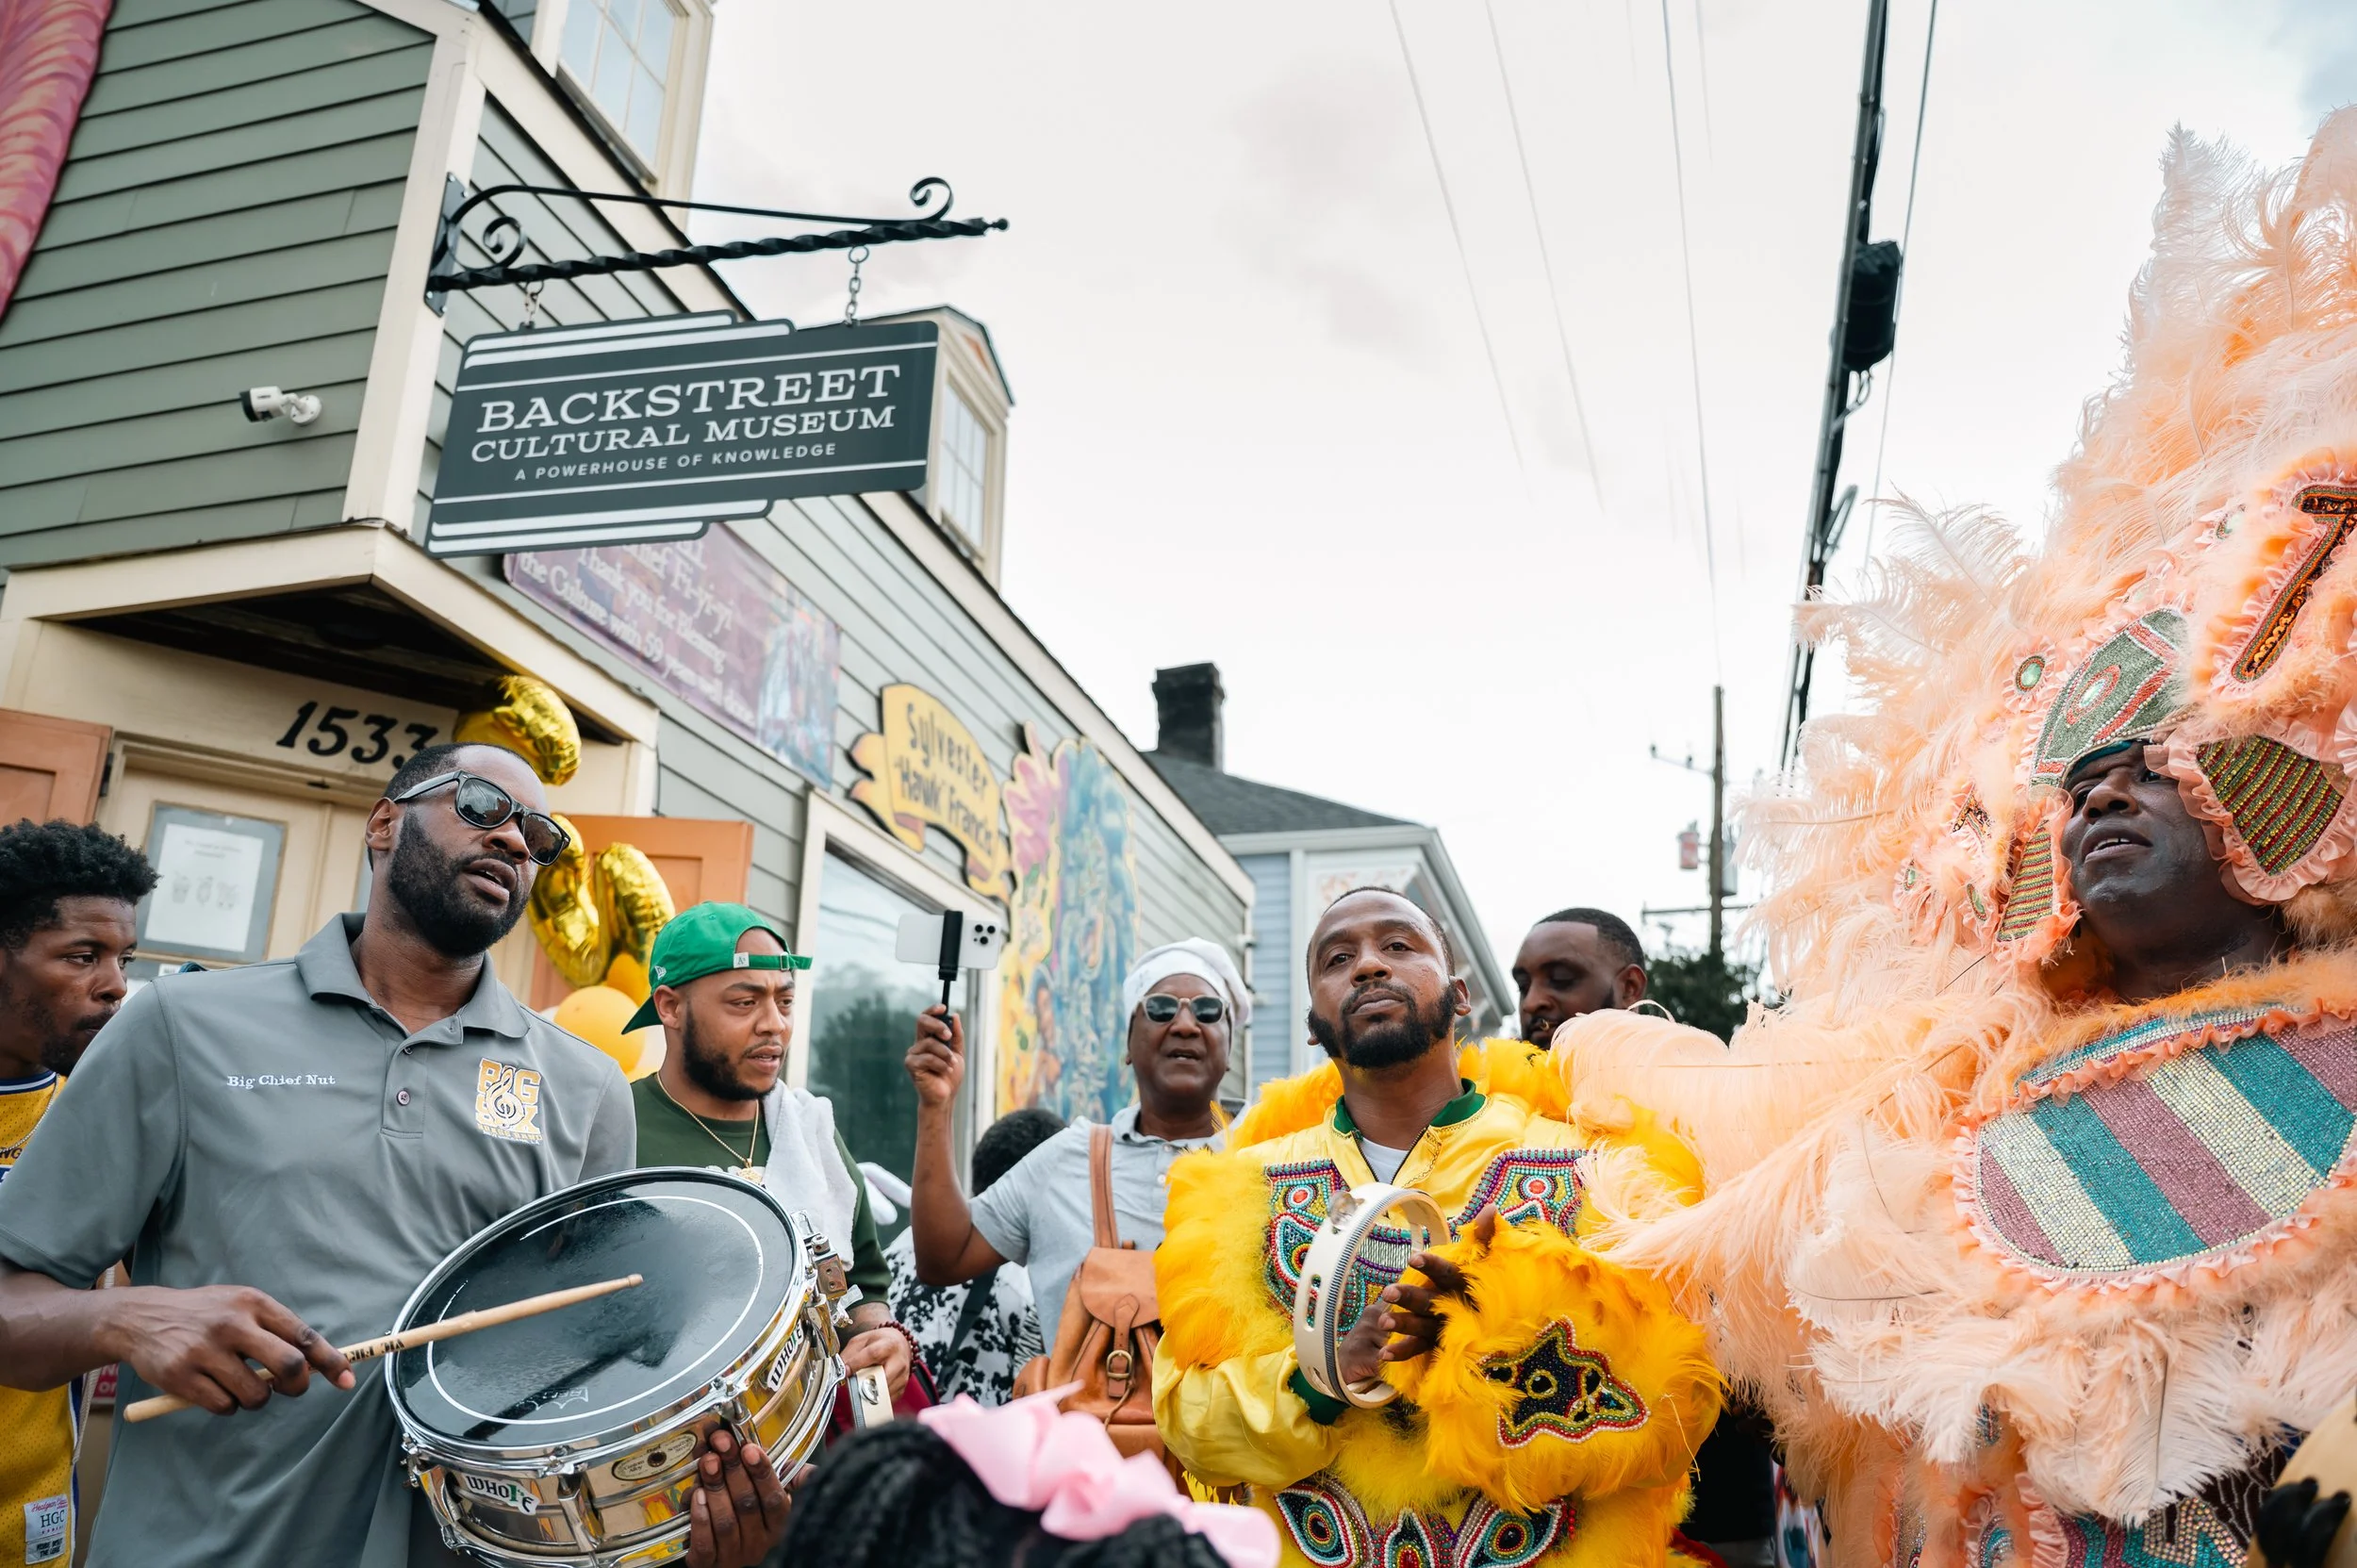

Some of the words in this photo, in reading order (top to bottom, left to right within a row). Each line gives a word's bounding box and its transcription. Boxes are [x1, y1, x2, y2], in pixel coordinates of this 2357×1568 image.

[476, 364, 900, 434] BACKSTREET
[471, 423, 690, 462] CULTURAL
[703, 405, 896, 442] MUSEUM
[514, 469, 526, 481] A
[535, 456, 668, 479] POWERHOUSE
[677, 454, 703, 468] OF
[712, 443, 836, 465] KNOWLEDGE
[550, 565, 608, 625] Culture
[276, 701, 438, 769] 1533
[907, 702, 988, 801] Sylvester
[226, 1076, 255, 1090] Big
[258, 1074, 303, 1085] Chief
[305, 1074, 336, 1084] Nut
[40, 1510, 65, 1527] HGC
